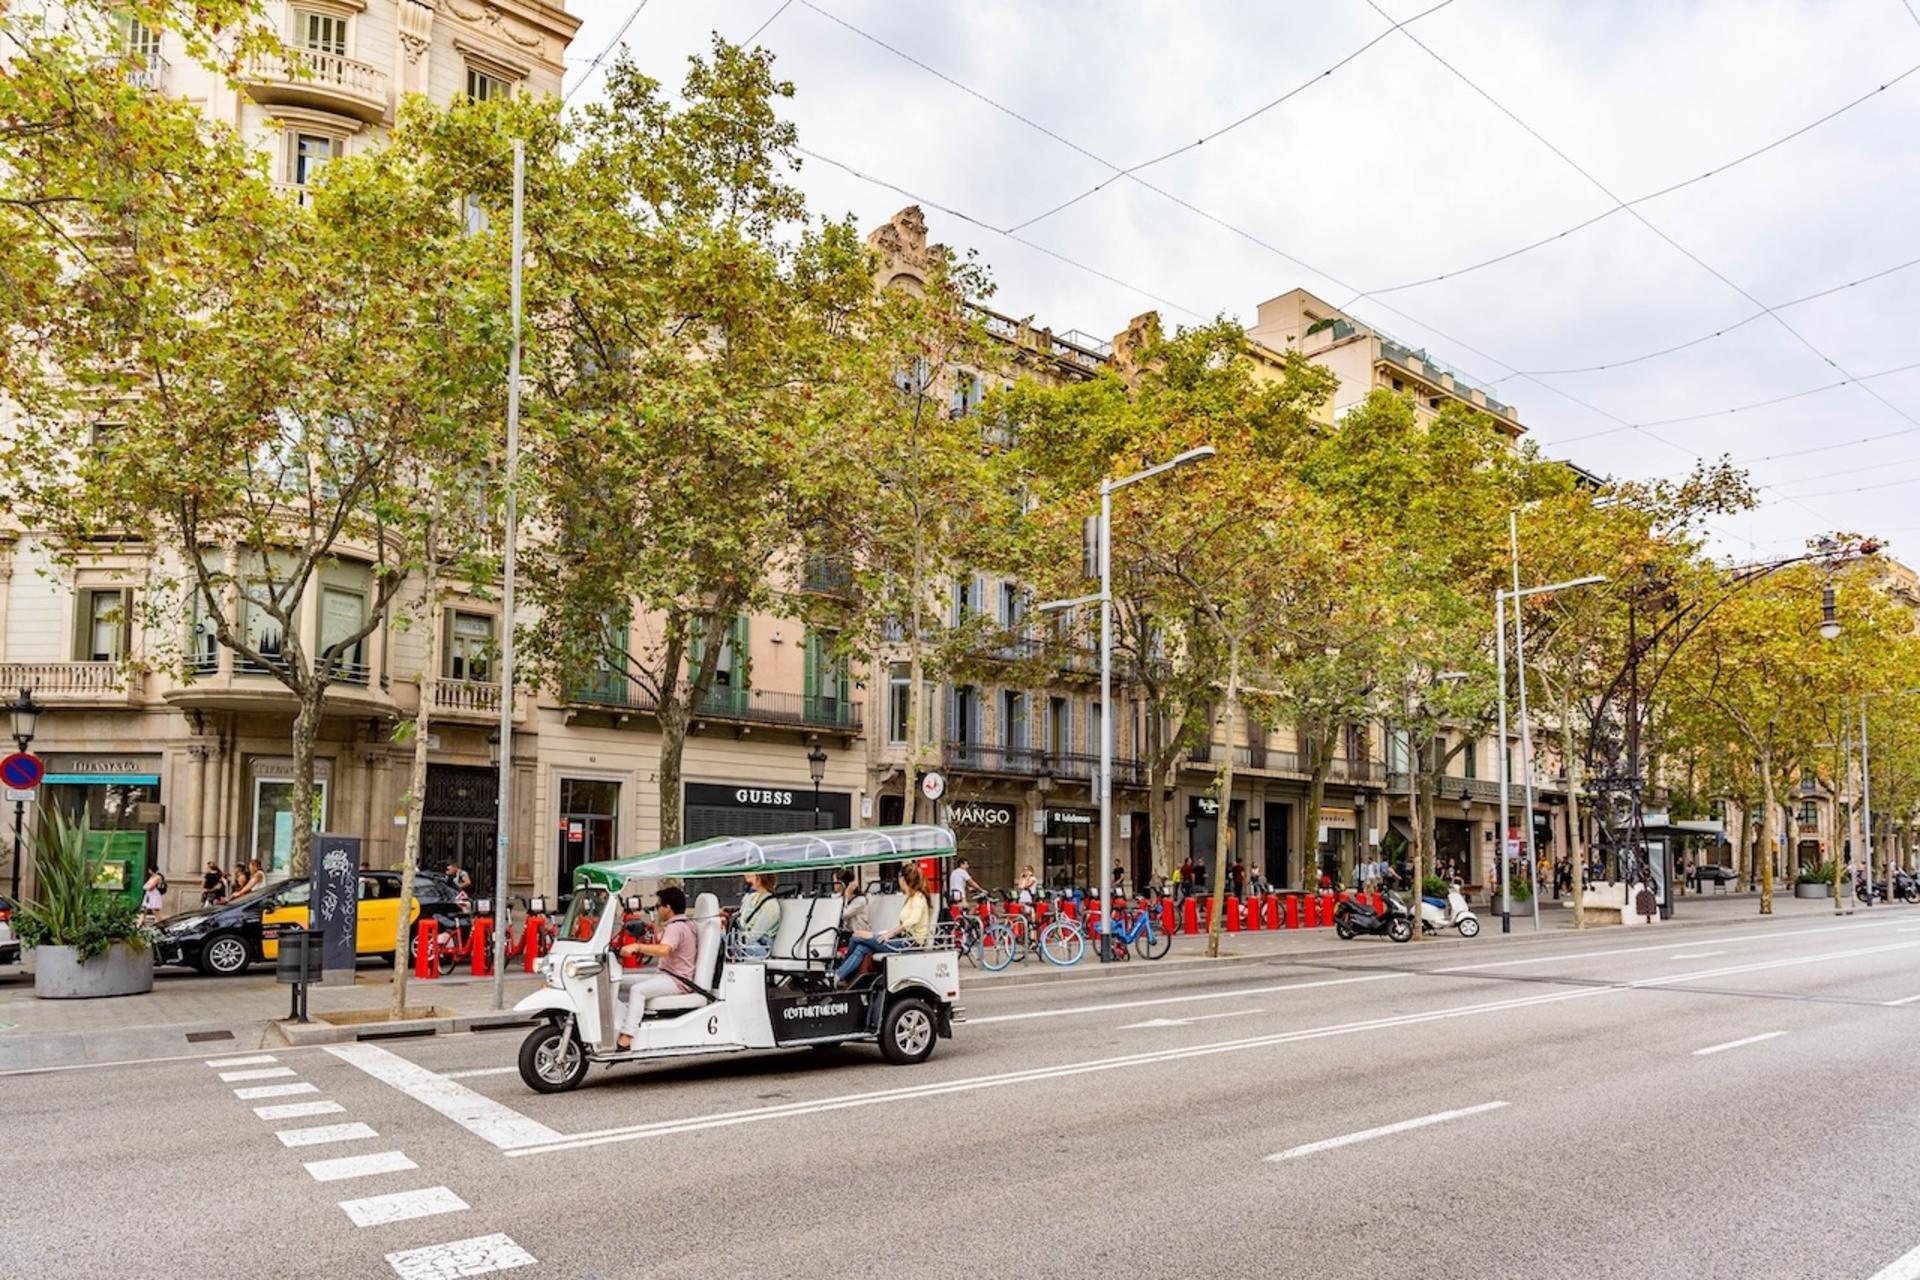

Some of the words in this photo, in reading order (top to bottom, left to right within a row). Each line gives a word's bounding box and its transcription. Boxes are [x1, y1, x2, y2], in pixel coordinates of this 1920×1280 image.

[735, 788, 793, 805] GUESS
[946, 804, 1010, 824] MANGO
[707, 1015, 718, 1036] 6
